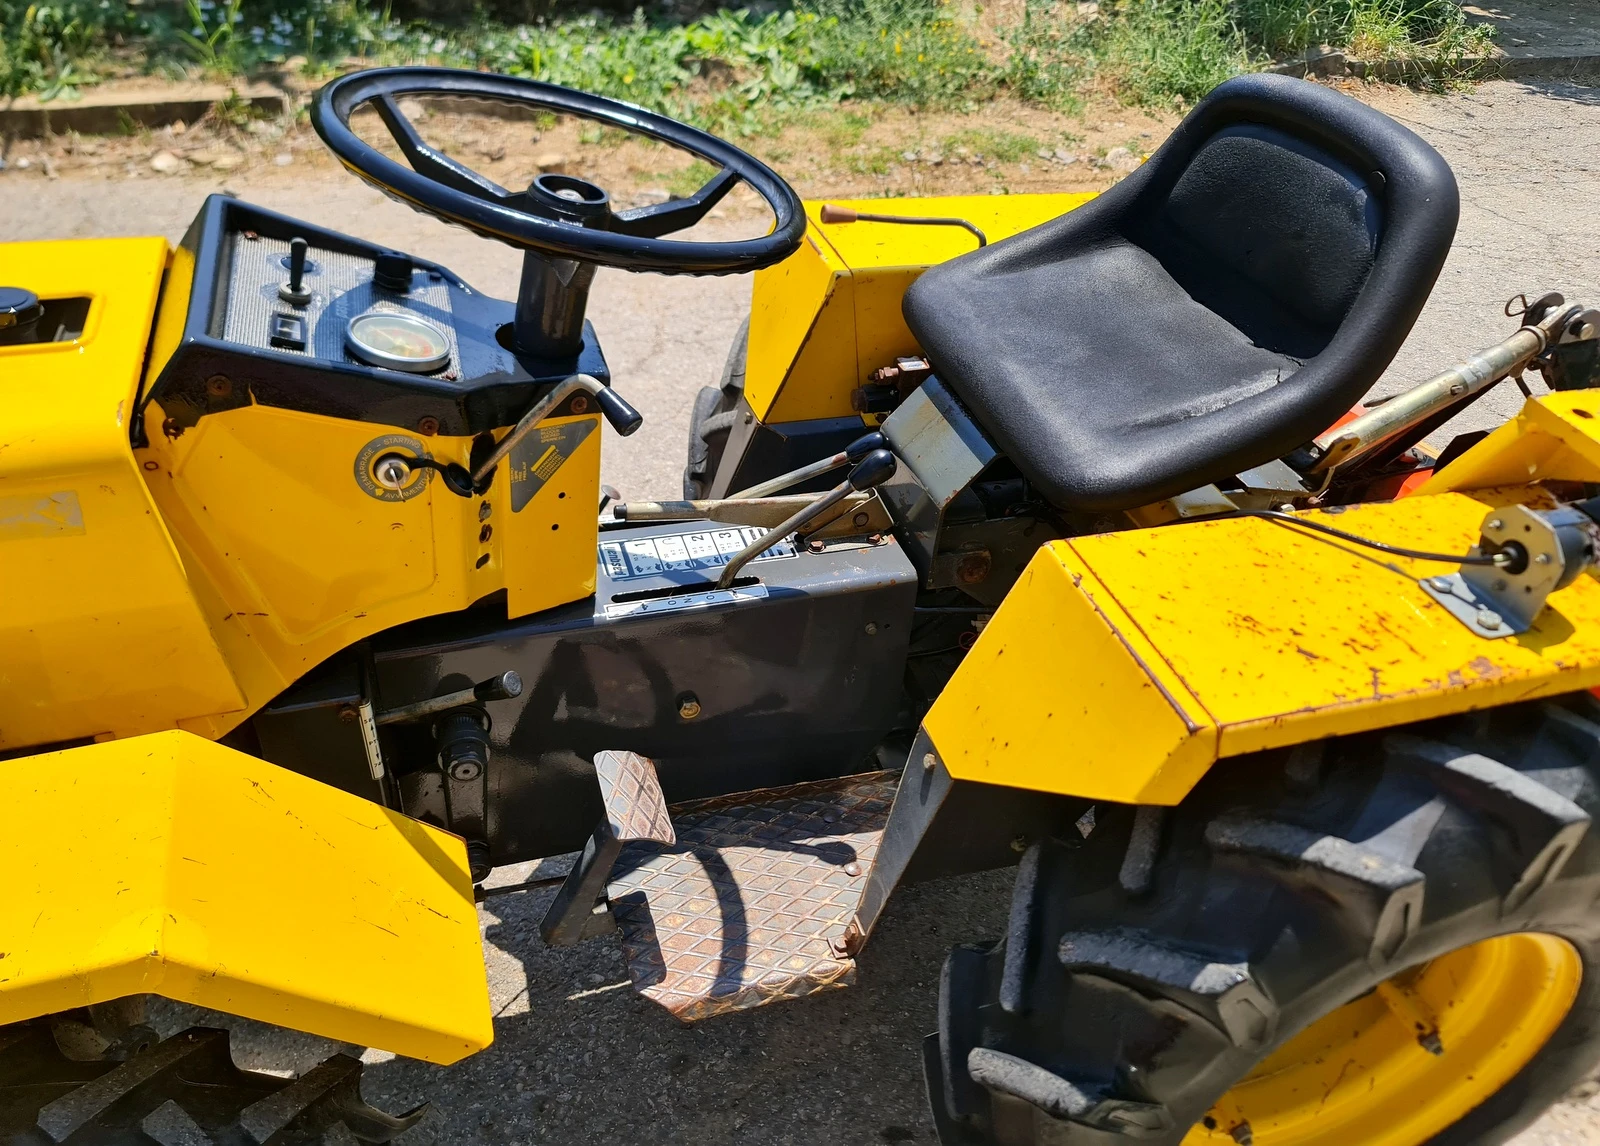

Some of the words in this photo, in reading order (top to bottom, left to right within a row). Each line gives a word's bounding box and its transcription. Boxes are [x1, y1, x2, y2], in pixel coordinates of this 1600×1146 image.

[360, 447, 375, 491] DEMARRAGE
[383, 437, 421, 449] STARTING
[691, 534, 704, 542] 2
[603, 546, 627, 576] pasquali
